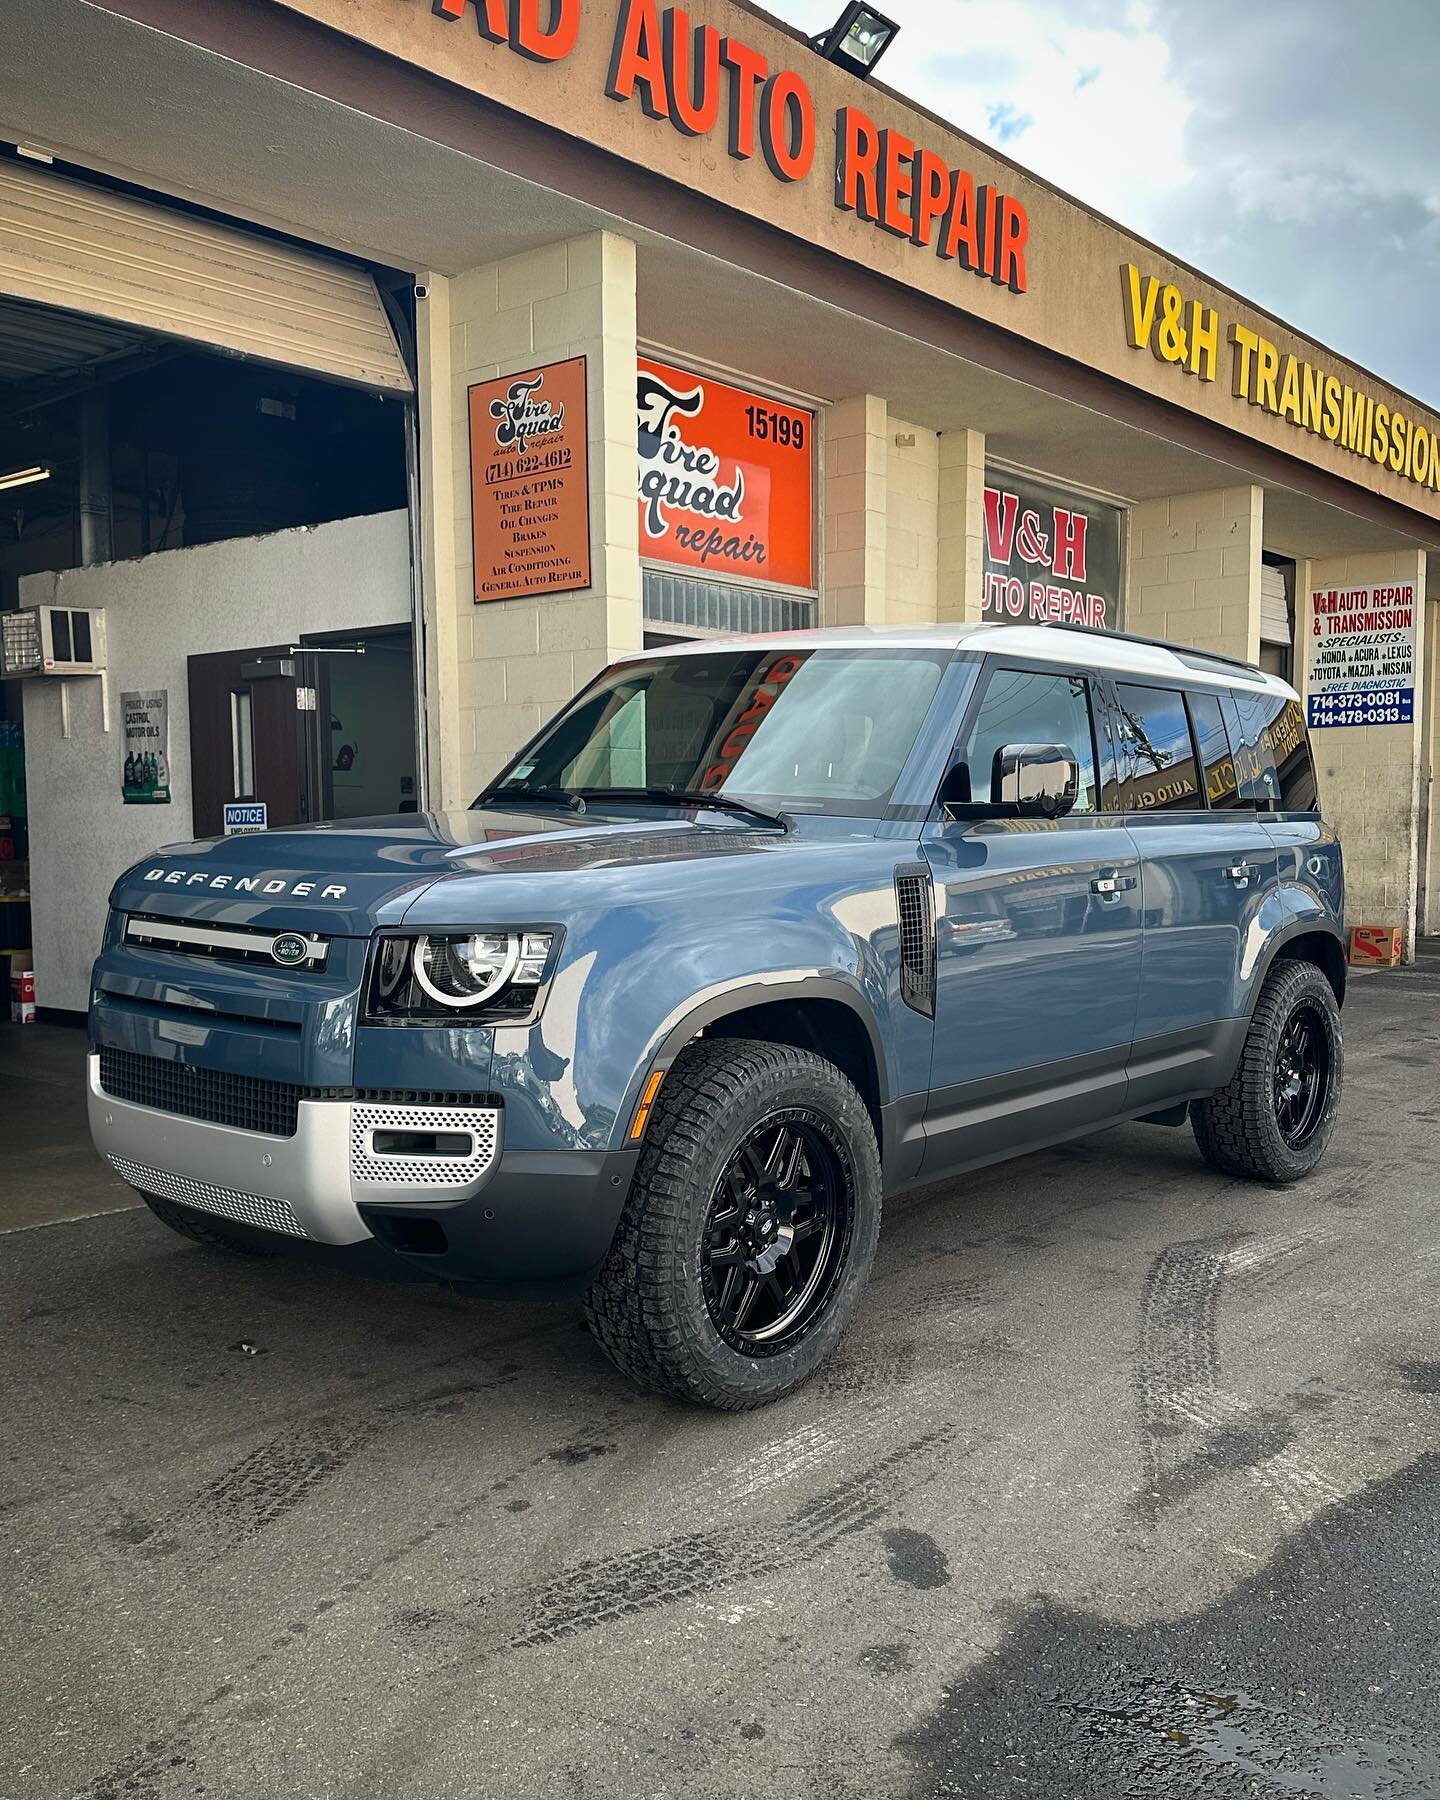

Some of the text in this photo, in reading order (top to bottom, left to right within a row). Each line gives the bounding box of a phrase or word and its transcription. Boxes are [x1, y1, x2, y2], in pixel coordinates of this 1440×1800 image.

[605, 0, 1027, 294] AUTO REPAIR
[1119, 263, 1440, 492] V&H TRANSMISSION
[490, 400, 564, 455] Squad
[745, 406, 804, 450] 15199
[493, 434, 564, 458] auto repair
[485, 449, 571, 482] (714) 622-4612
[493, 479, 564, 502] TIRES & TPMS
[637, 464, 742, 535] quad
[500, 497, 557, 515] TIRE REPAIR
[500, 512, 559, 530] OIL CHANGES
[512, 530, 547, 543] BRAKES
[676, 525, 766, 564] repair
[983, 487, 1088, 583] V&H
[504, 544, 556, 559] SUSPENSION
[491, 557, 571, 577] AIR CONDITIONING
[482, 569, 582, 593] GENERAL AUTO REPAIR
[982, 572, 1106, 629] UTO REPAIR
[1313, 586, 1413, 615] V&H AUTO REPAIR
[1313, 609, 1412, 636] & TRANSMISSION
[1322, 645, 1412, 664] HONDA ACURA LEXUS
[1313, 661, 1412, 680] TOYOTA MAZDA NISSAN
[1326, 678, 1406, 692] FREE DIAGNOSTIC
[1312, 691, 1400, 710] 714-373-0081
[1312, 708, 1399, 725] 714-478-0313
[228, 809, 262, 822] NOTICE
[143, 868, 348, 899] DEFENDER
